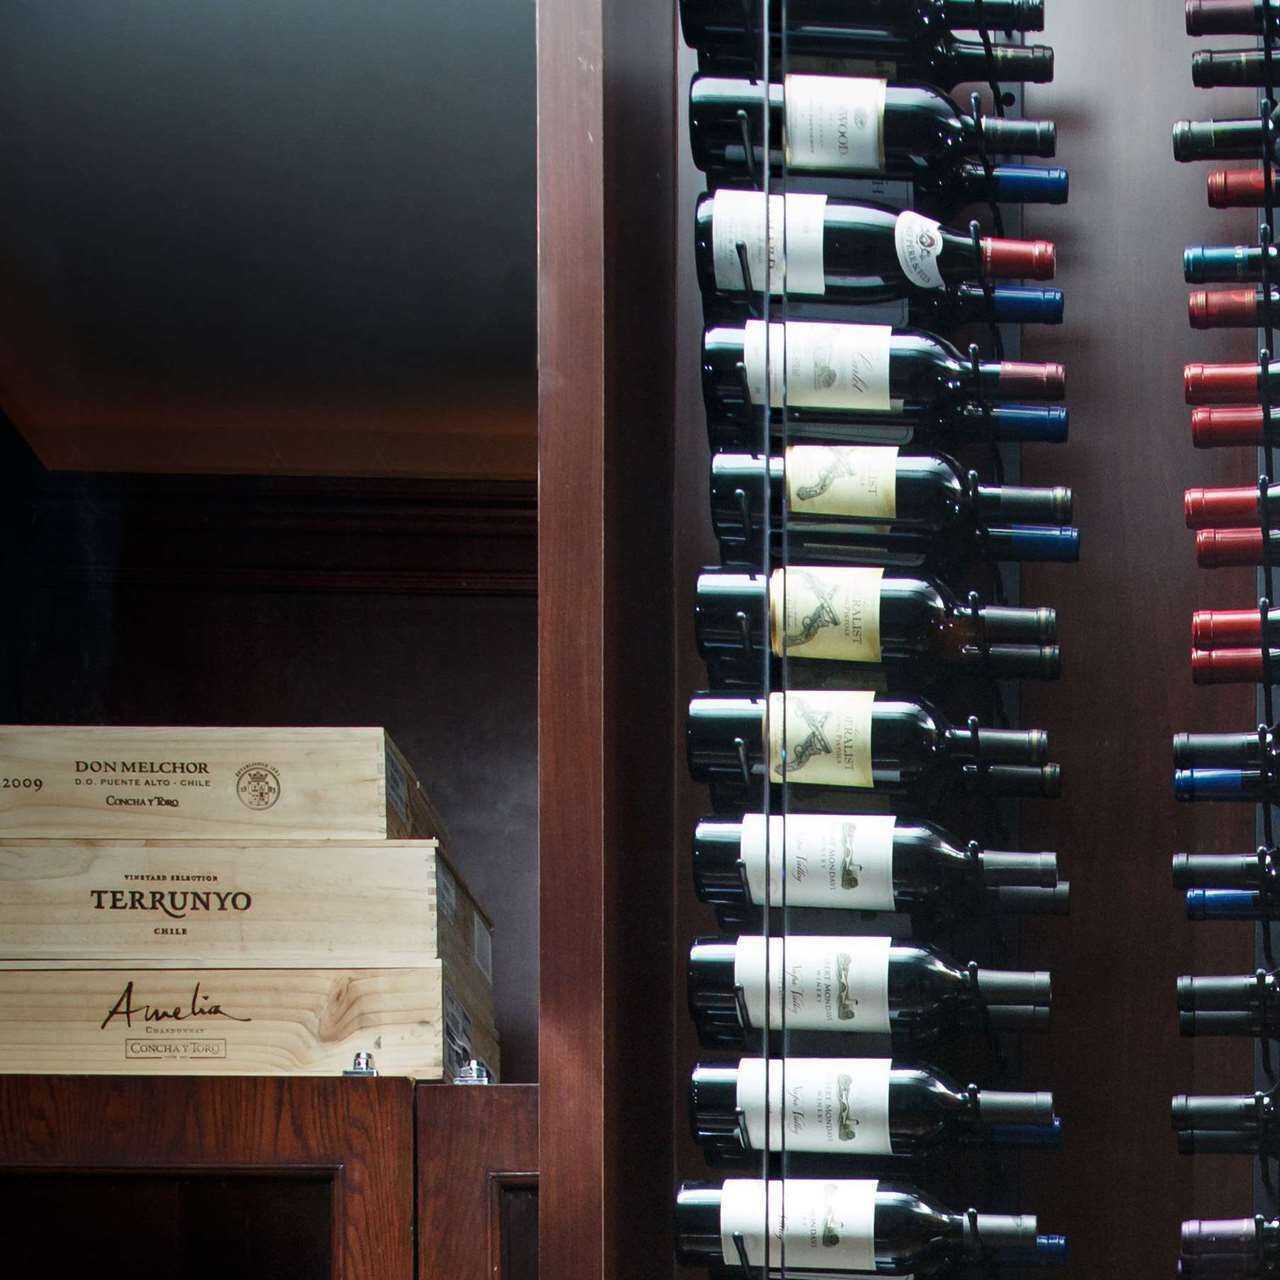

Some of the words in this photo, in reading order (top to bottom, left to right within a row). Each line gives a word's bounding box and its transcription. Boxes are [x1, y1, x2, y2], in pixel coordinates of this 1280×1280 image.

[74, 760, 117, 775] DON
[121, 760, 210, 775] MELCHOR
[2, 777, 44, 792] 2009
[100, 778, 141, 787] PUENTE
[144, 779, 170, 787] ALTO
[179, 779, 211, 788] CHILE
[105, 795, 147, 808] CONCHA
[826, 847, 838, 891] MONDAVI
[123, 874, 168, 882] VINEYARD
[170, 874, 219, 883] SELECTION
[90, 889, 252, 919] TERRUNYO
[153, 927, 188, 936] CHILE
[100, 980, 252, 1030] Amelia
[822, 983, 834, 1023] MONDAVI
[824, 1103, 835, 1142] MONDAVI
